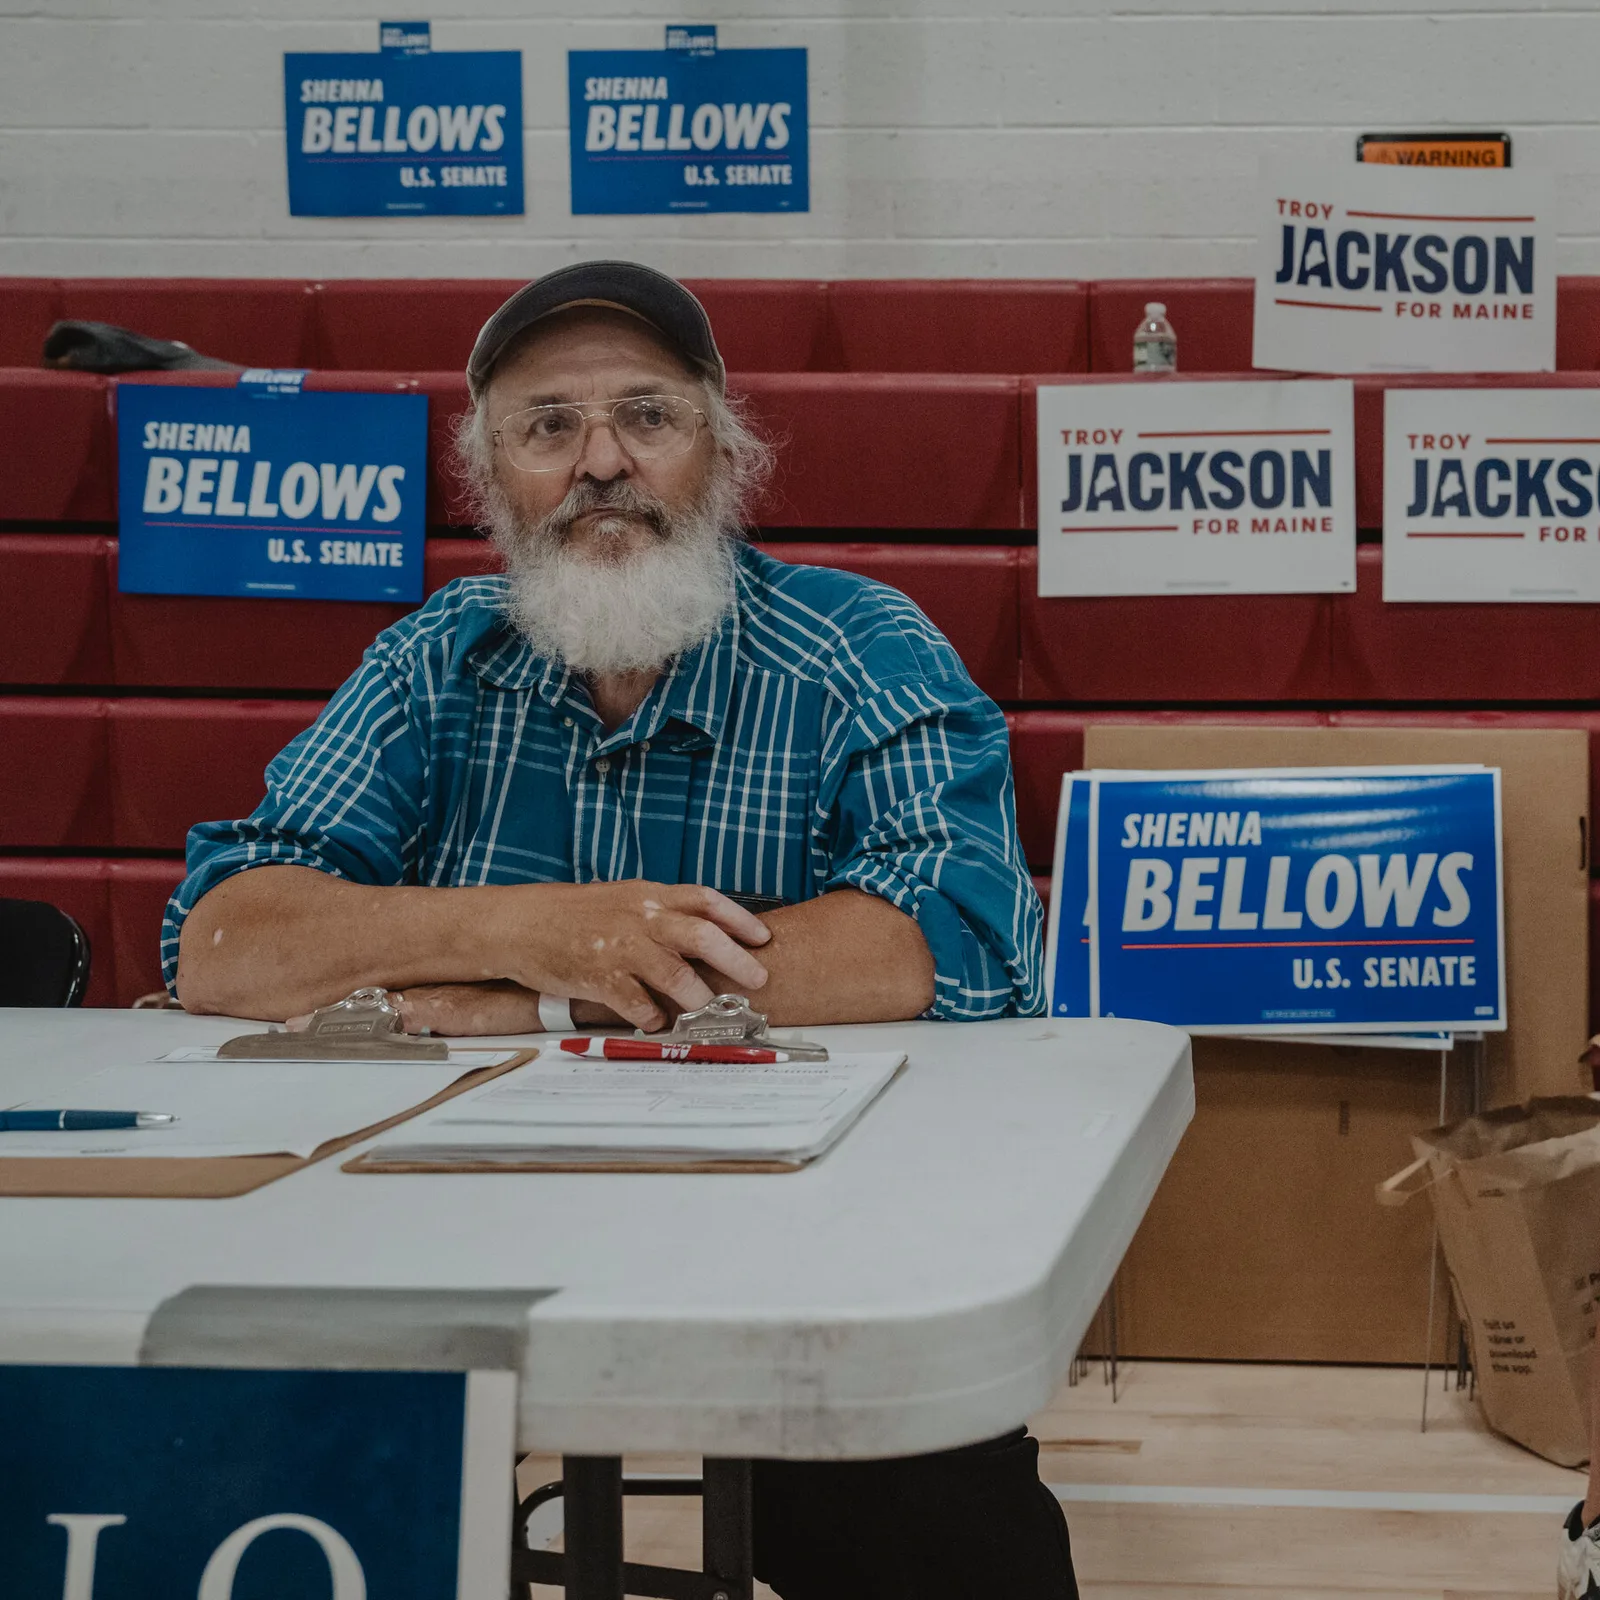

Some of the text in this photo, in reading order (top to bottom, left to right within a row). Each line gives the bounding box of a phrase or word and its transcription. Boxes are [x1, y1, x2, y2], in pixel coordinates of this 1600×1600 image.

[300, 79, 384, 103] SHENNA
[584, 76, 668, 101] SHENNA
[302, 104, 507, 154] BELLOWS
[585, 102, 792, 152] BELLOWS
[1397, 149, 1497, 167] WARNING
[400, 165, 508, 188] U.S. SENATE
[684, 164, 793, 187] U.S. SENATE
[1276, 198, 1334, 221] TROY
[1275, 224, 1535, 295] JACKSON
[1395, 301, 1534, 319] FOR MAINE
[142, 421, 251, 453] SHENNA
[1060, 429, 1124, 446] TROY
[1407, 434, 1471, 450] TROY
[142, 456, 406, 523] BELLOWS
[1061, 449, 1333, 513] JACKSON
[1406, 457, 1600, 518] JACKS
[1193, 516, 1333, 535] FOR MAINE
[1539, 526, 1587, 542] FOR
[267, 538, 404, 567] U.S. SENATE
[1121, 811, 1263, 849] SHENNA
[1121, 851, 1474, 932] BELLOWS
[1293, 955, 1476, 989] U.S. SENATE
